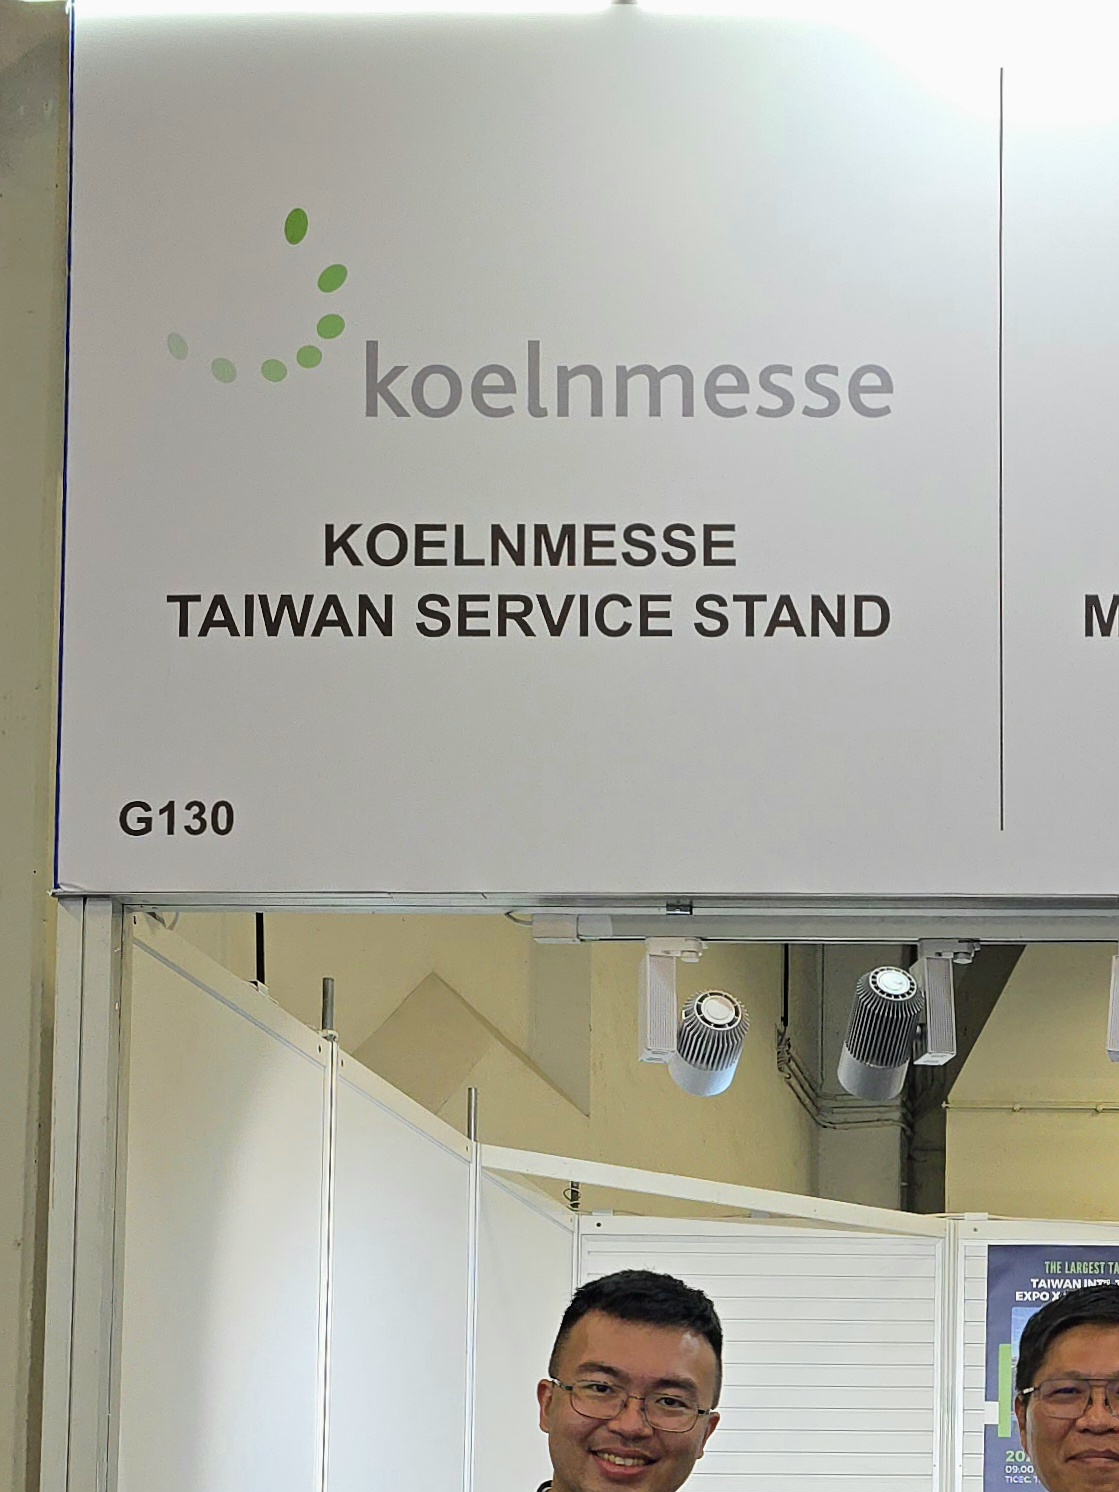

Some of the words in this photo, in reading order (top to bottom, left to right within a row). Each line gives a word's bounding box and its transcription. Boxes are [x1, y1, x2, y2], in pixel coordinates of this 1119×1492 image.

[365, 340, 894, 418] koelnmesse
[324, 523, 737, 567] KOELNMESSE
[166, 595, 393, 637] TAIWAN
[415, 594, 673, 637] SERVICE
[693, 594, 891, 637] STAND
[119, 800, 234, 836] G130
[1031, 1278, 1081, 1289] TAIWAN
[1045, 1261, 1062, 1274] THE
[1065, 1261, 1105, 1275] LARGEST
[1015, 1291, 1050, 1302] EXPO
